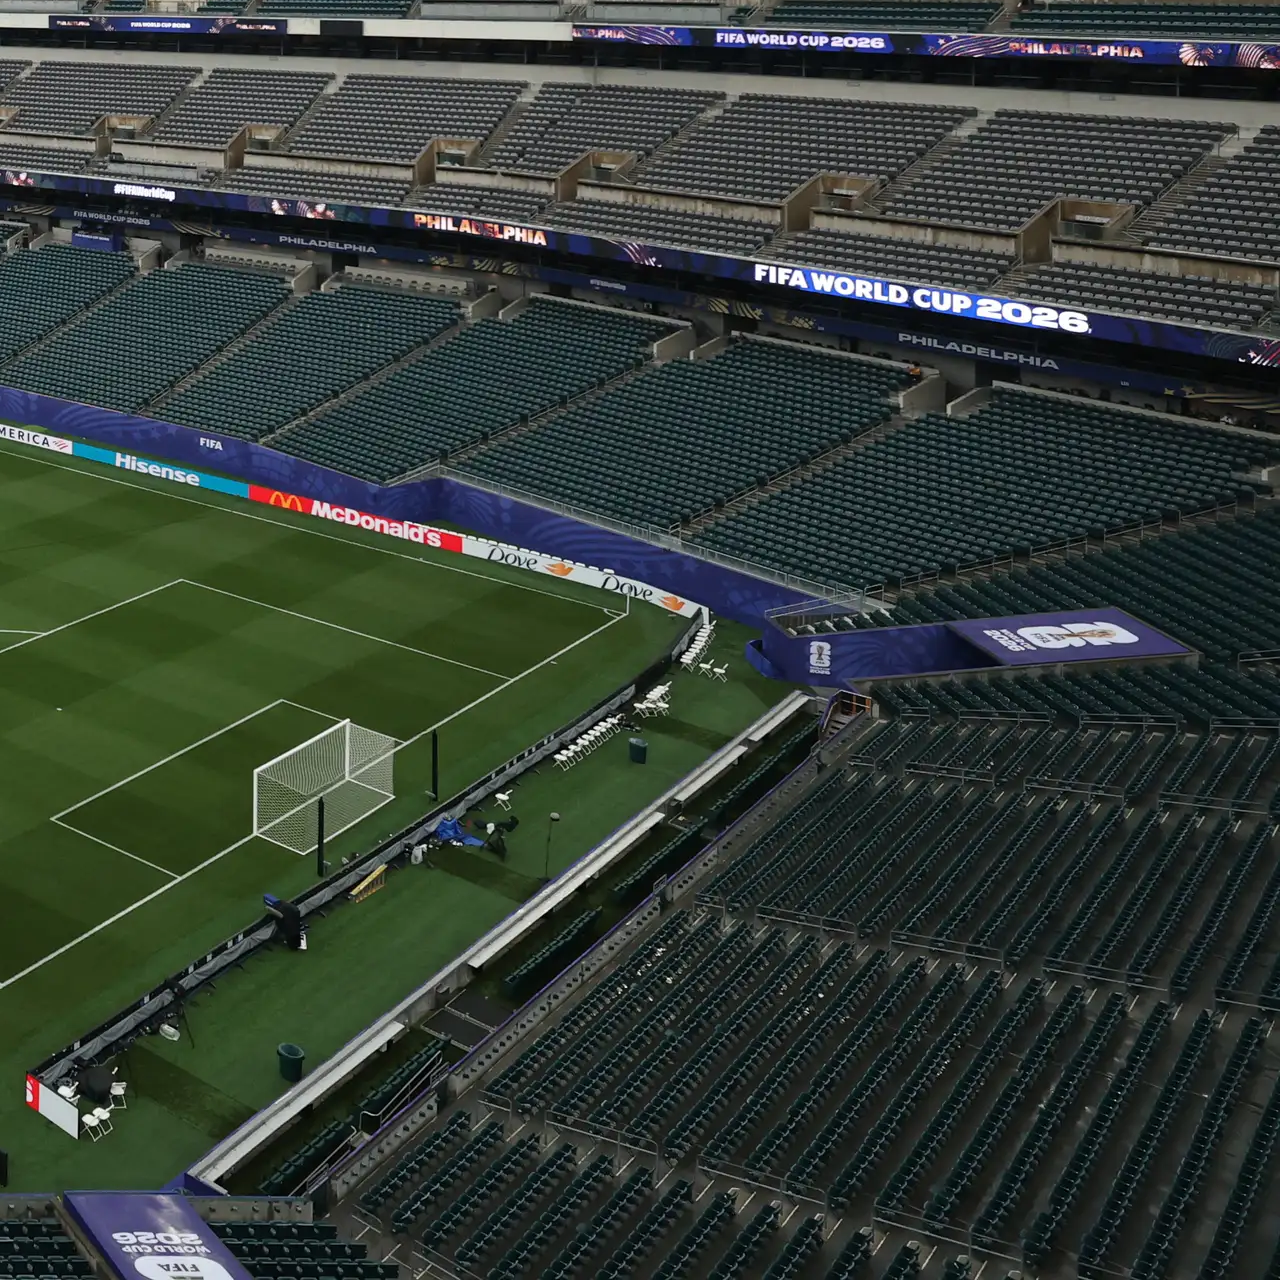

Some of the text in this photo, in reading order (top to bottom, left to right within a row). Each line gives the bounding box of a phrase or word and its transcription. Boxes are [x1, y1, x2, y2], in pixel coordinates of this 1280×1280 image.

[716, 32, 885, 49] FIFA WORLD CUP 2026
[1009, 42, 1144, 58] PHILADELPHIA
[114, 183, 176, 202] #FIFAWorldCup
[73, 210, 151, 226] FIFA WORLD CUP 2026
[414, 213, 547, 246] PHILADELPHIA
[279, 235, 377, 254] PHILADELPHIA
[754, 263, 1090, 334] FIFA WORLD CUP 2026
[898, 332, 1060, 370] PHILADELPHIA
[199, 437, 223, 451] FIFA
[115, 452, 200, 487] Hisense
[311, 500, 442, 548] McDonald's
[487, 545, 538, 571] Dove
[601, 573, 653, 602] Dove
[983, 629, 1023, 652] 2026
[111, 1231, 203, 1245] 2026
[121, 1244, 211, 1254] WORLD CUP
[157, 1263, 200, 1272] FIFA
